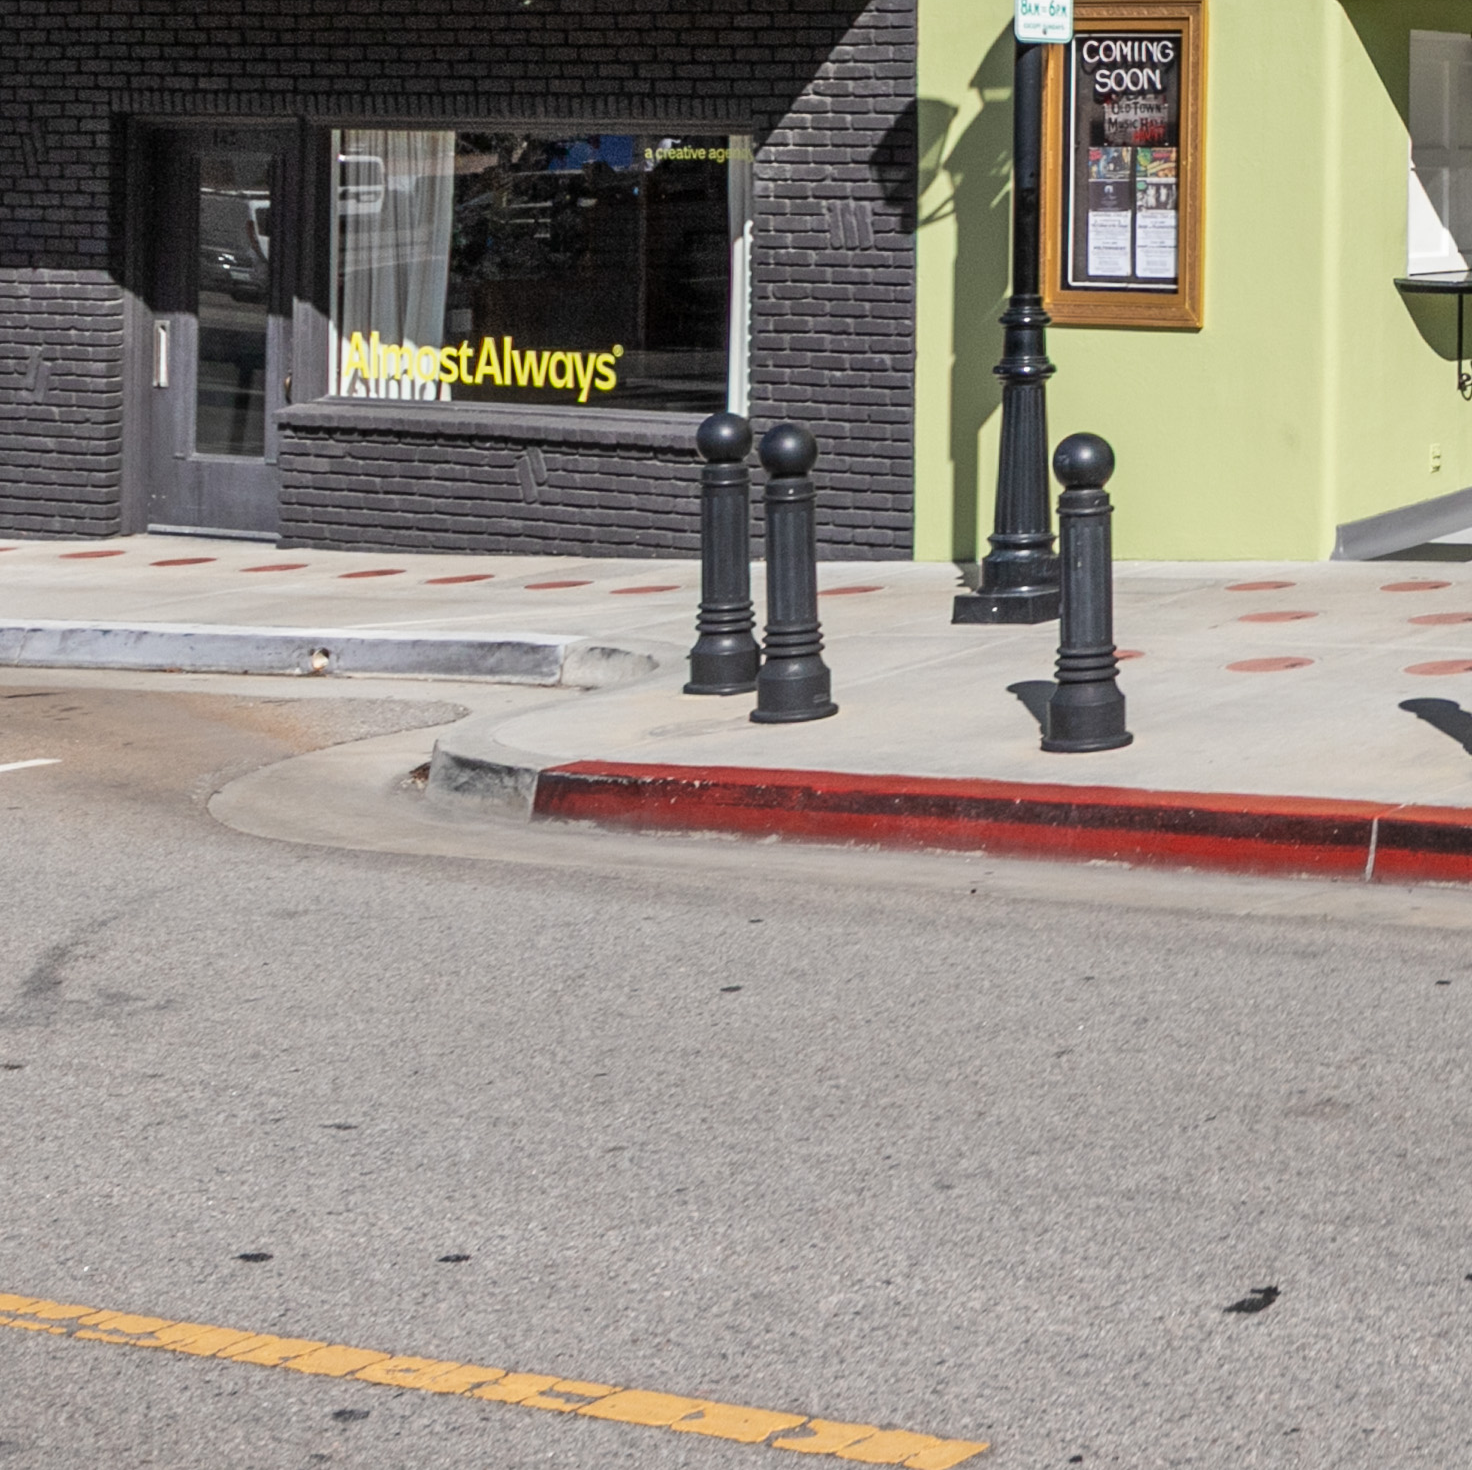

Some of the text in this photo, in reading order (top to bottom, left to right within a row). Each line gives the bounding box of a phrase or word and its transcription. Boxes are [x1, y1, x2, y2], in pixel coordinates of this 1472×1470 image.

[1082, 40, 1175, 63] COMING
[1095, 67, 1162, 92] SOON
[1132, 101, 1162, 115] TOWN
[644, 147, 653, 159] a
[655, 145, 706, 159] creative
